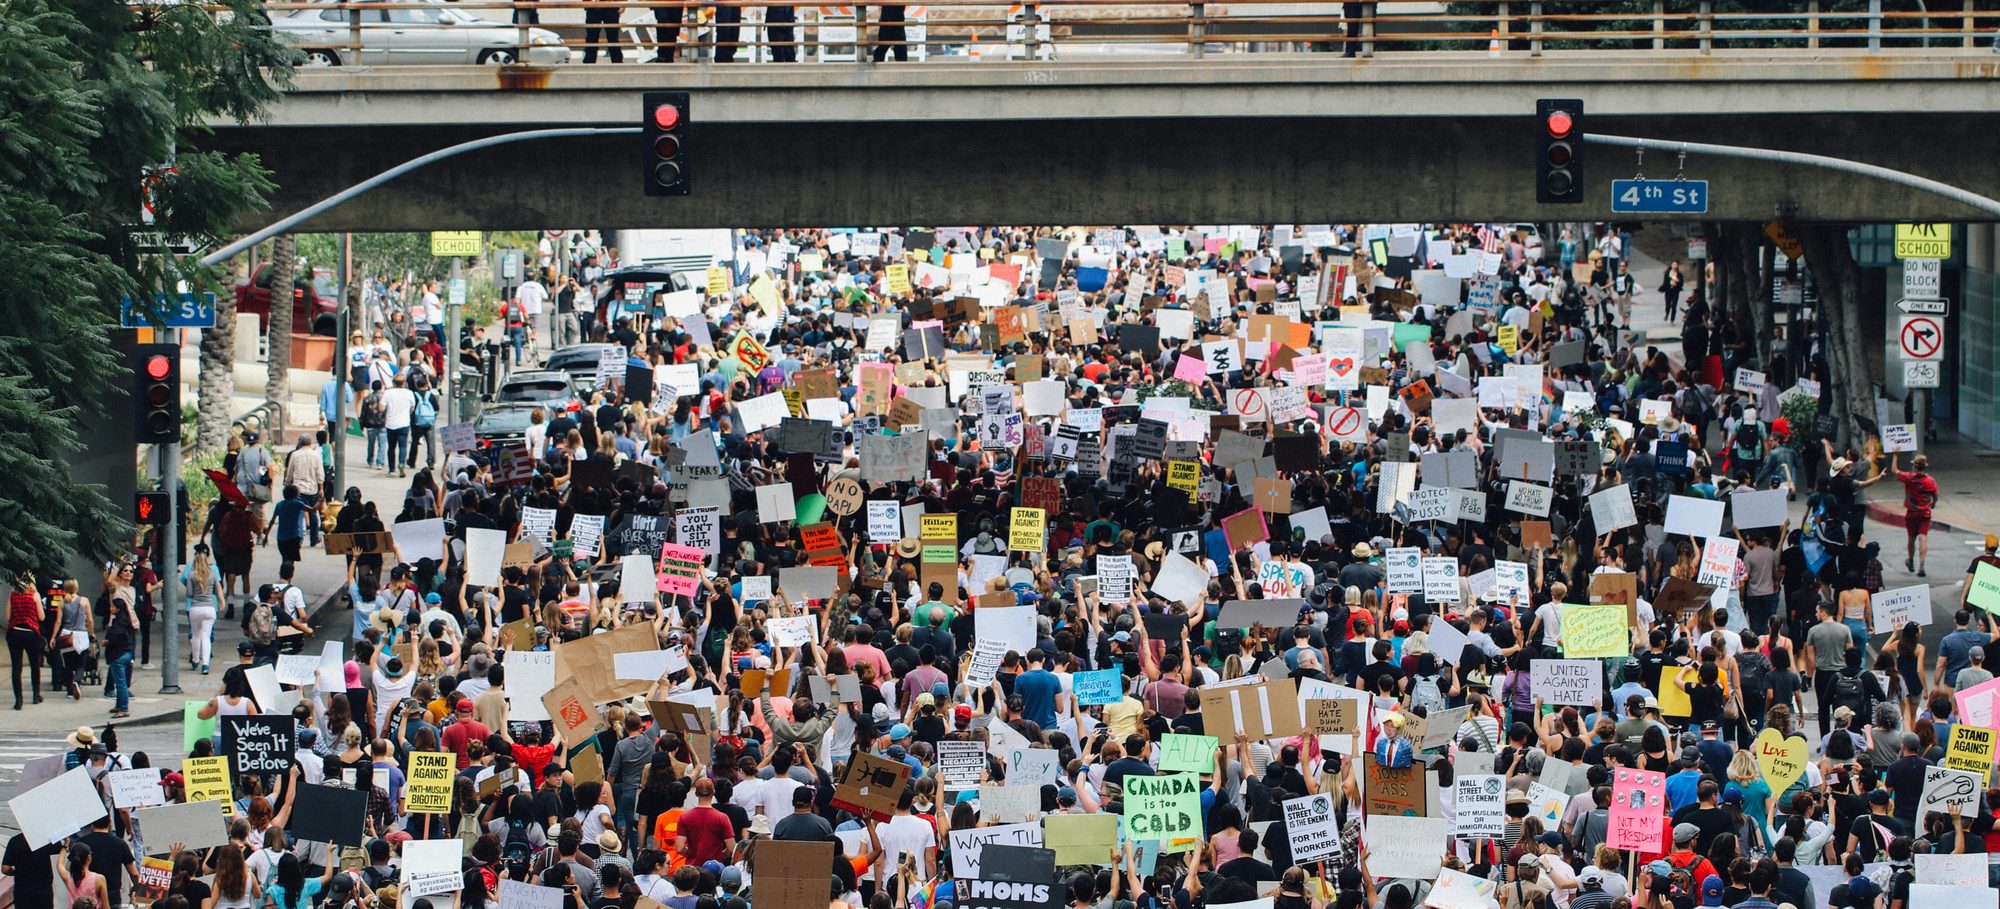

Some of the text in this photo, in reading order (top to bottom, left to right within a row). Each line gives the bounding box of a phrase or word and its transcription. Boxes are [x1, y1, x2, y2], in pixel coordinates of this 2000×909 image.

[1620, 187, 1699, 206] 4th St
[436, 241, 478, 252] SCHOOL
[1899, 243, 1946, 255] SCHOOL
[1906, 262, 1938, 272] DO NOT
[1906, 275, 1938, 286] BLOCK
[1910, 302, 1944, 311] ONE WAY
[968, 371, 1004, 383] OBSTRUCT
[1658, 456, 1684, 466] THINK
[675, 466, 718, 476] 4 YEARS
[1173, 464, 1195, 472] STAND
[1171, 471, 1196, 480] AGAINST
[834, 483, 858, 496] NO
[1023, 478, 1056, 490] CIVIL
[1409, 488, 1449, 500] PROTECT
[1518, 487, 1526, 495] NO
[827, 494, 854, 514] DAPL
[1524, 495, 1543, 504] TRUMP
[1016, 510, 1039, 519] STAND
[1412, 506, 1447, 519] PUSSY
[1469, 506, 1482, 516] BAD
[632, 515, 658, 531] Hate
[686, 515, 708, 523] YOU
[923, 518, 954, 526] Hillary
[1015, 519, 1040, 527] AGAINST
[682, 523, 713, 532] CAN'T
[804, 529, 829, 538] TRUMP
[620, 528, 665, 544] NEVER MADE
[689, 532, 705, 540] SIT
[1012, 537, 1039, 545] BIGOTRY!
[685, 538, 711, 548] WITH
[1706, 541, 1736, 560] LOVE
[1390, 580, 1421, 588] WORKERS
[1701, 572, 1728, 589] HATE
[1262, 581, 1296, 594] LOV
[1885, 595, 1912, 607] UNITED
[1890, 615, 1909, 624] HATE
[1550, 664, 1588, 676] UNITED
[1079, 680, 1112, 690] SURVIVING
[1542, 677, 1589, 689] AGAINST
[1553, 690, 1584, 702] HATE
[1321, 700, 1338, 709] END
[1318, 709, 1342, 718] HATE
[231, 719, 271, 737] We've
[1315, 726, 1344, 734] TRUMP
[1957, 728, 1989, 743] STAND
[236, 734, 289, 752] Seen It
[1953, 740, 1990, 755] AGAINST
[1166, 736, 1217, 764] ALLY
[196, 758, 218, 766] Resistir
[237, 751, 288, 772] Before
[416, 756, 448, 767] STAND
[1774, 758, 1797, 772] trumps
[1947, 757, 1990, 770] ANTI-MUSLIM
[413, 768, 449, 780] AGAINST
[1771, 766, 1789, 779] hate
[1927, 769, 1949, 783] SAFE
[1127, 777, 1196, 796] CANADA
[1459, 779, 1477, 787] WALL
[409, 785, 451, 794] ANTI-MUSLIM
[1381, 782, 1409, 797] ASS
[1459, 787, 1482, 795] STREET
[411, 794, 447, 805] BIGOTRY!
[1144, 798, 1155, 809] is
[1476, 795, 1501, 803] ENEMY.
[1946, 795, 1974, 806] PLACE
[1286, 802, 1305, 812] WALL
[1288, 809, 1313, 821] STREET
[1289, 813, 1332, 829] IS THE ENEMY.
[1130, 811, 1191, 833] COLD
[1617, 816, 1657, 829] NOT MY
[955, 833, 1001, 850] WAIT
[1292, 829, 1328, 845] FOR THE
[1294, 839, 1338, 855] WORKERS
[140, 866, 172, 879] DONALD
[432, 883, 453, 892] nombre
[502, 880, 548, 901] ANGRY
[970, 880, 1050, 903] MOMS
